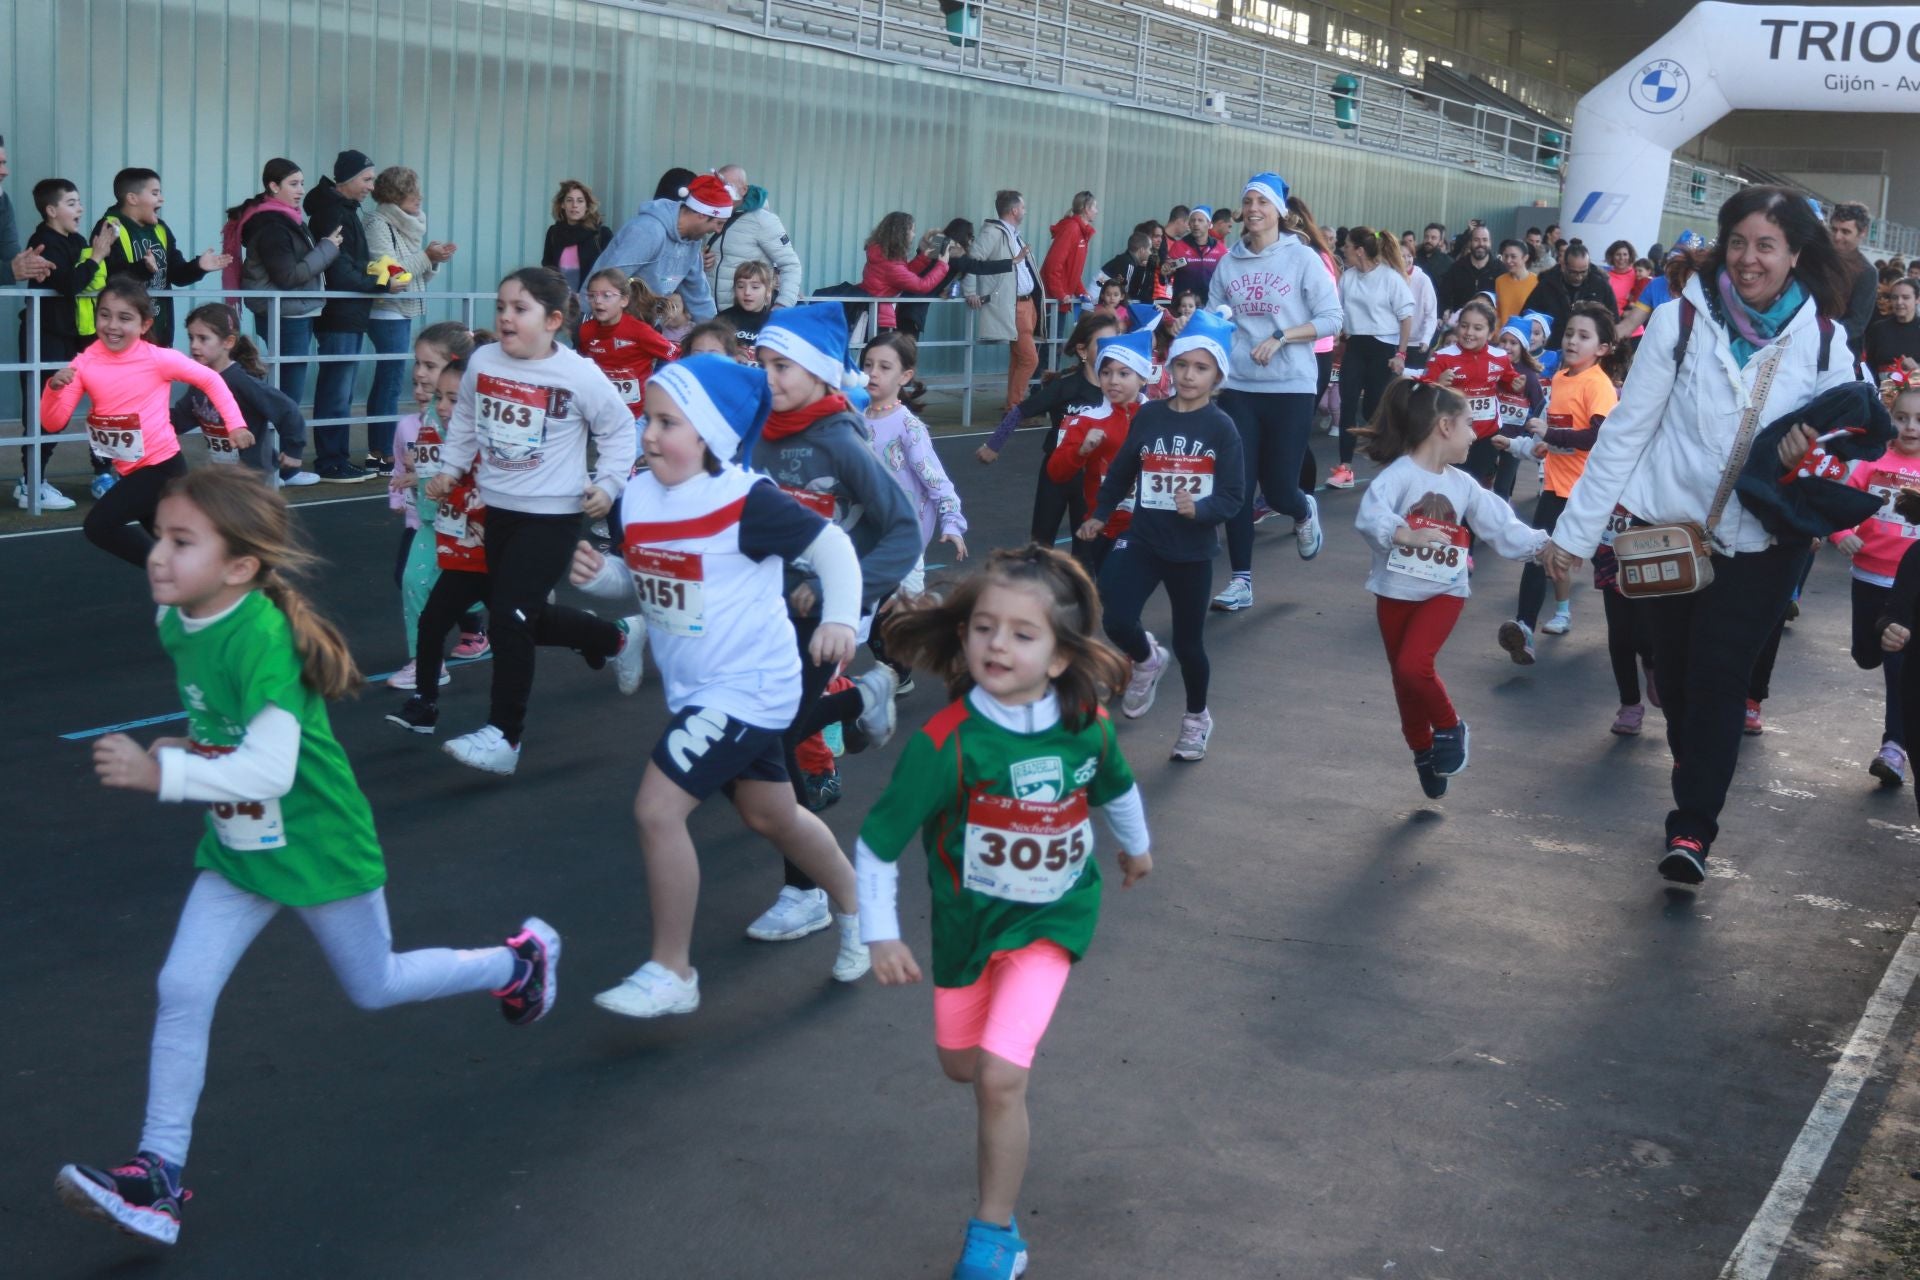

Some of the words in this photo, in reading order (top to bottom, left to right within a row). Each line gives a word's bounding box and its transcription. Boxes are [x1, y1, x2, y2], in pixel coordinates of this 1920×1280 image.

[1824, 74, 1875, 93] Gijón
[1246, 286, 1264, 300] 76
[481, 397, 532, 428] 3163
[780, 447, 813, 459] STITCH
[1151, 474, 1202, 495] 3122
[633, 574, 685, 612] 3151
[1019, 802, 1059, 814] Carrera
[978, 828, 1086, 872] 3055
